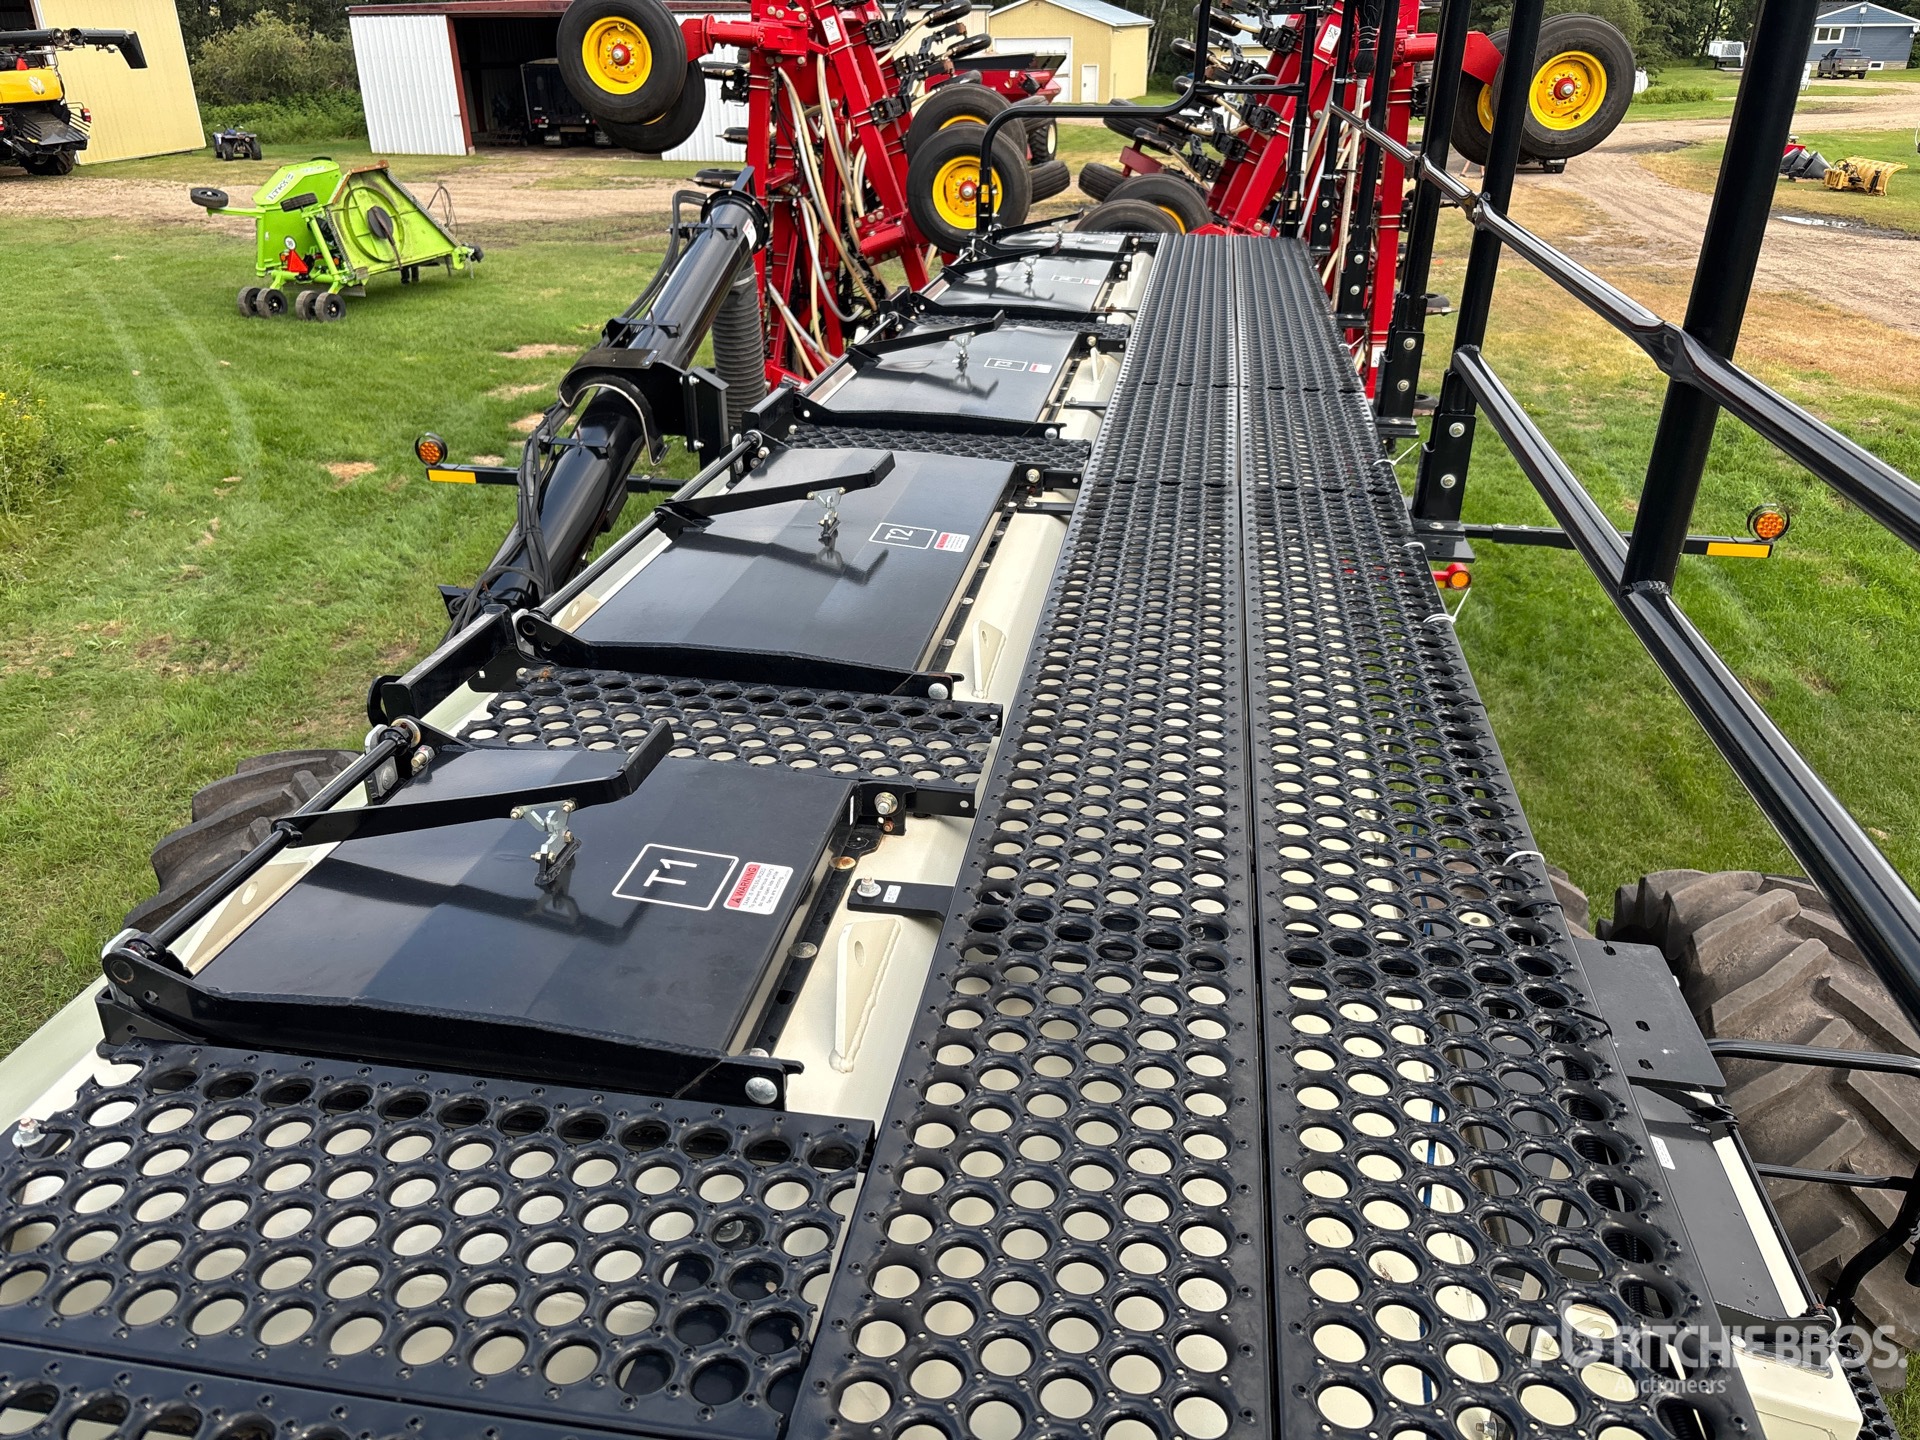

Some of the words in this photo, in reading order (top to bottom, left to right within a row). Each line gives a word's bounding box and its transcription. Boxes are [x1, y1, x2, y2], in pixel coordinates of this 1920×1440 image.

[884, 528, 914, 541] T2
[643, 858, 698, 887] T1
[734, 867, 757, 896] WARNING
